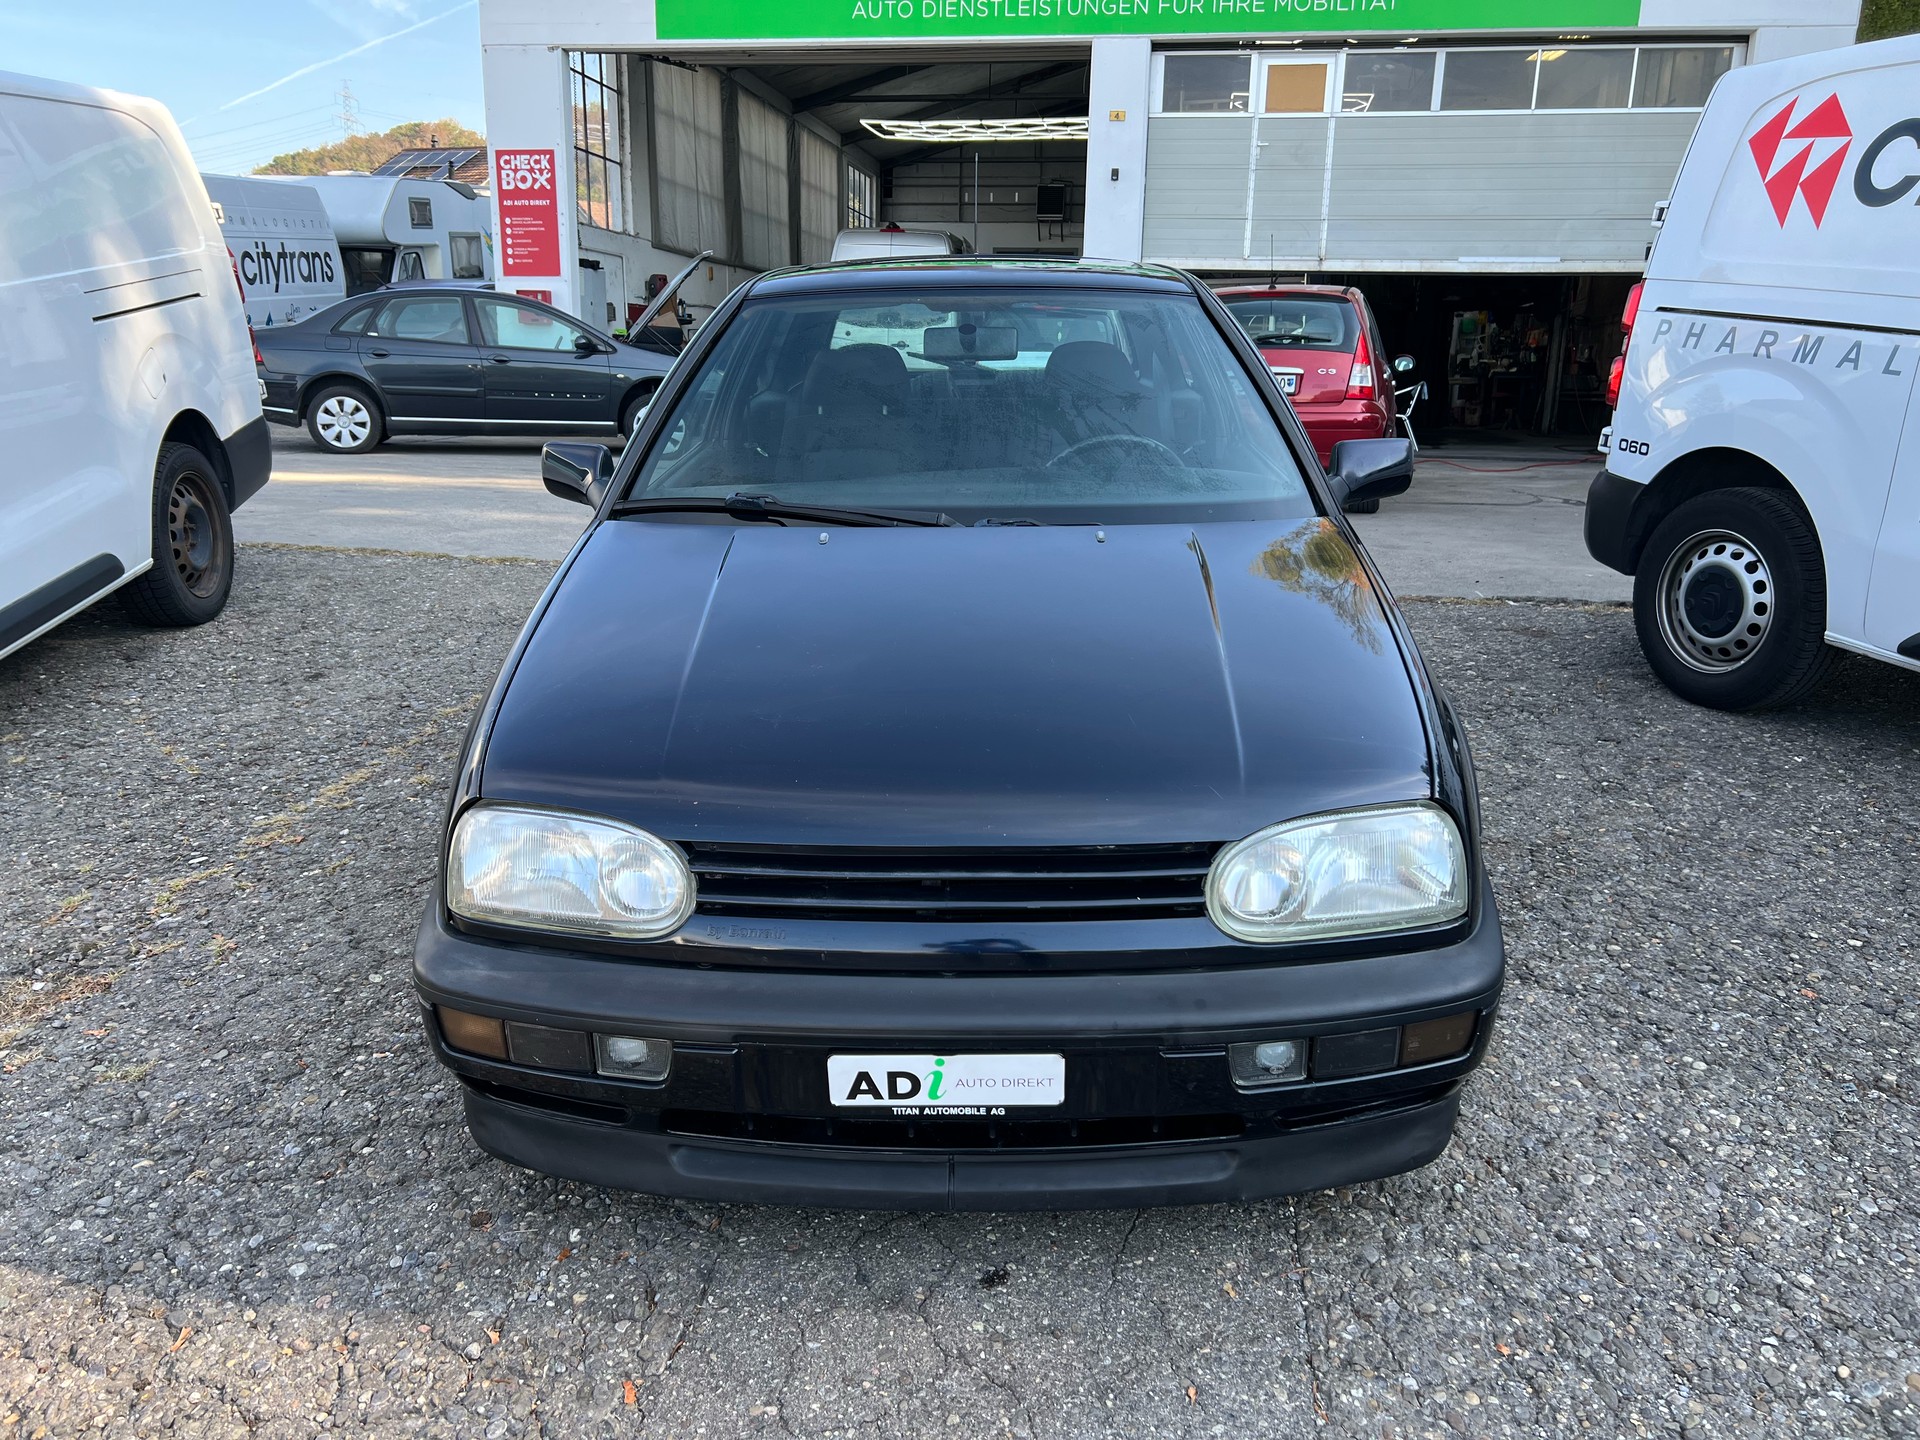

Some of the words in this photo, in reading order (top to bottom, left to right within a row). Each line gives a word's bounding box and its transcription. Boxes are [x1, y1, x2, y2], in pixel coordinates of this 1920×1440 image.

[851, 0, 913, 19] AUTO
[922, 0, 1148, 18] DIENSTLEISTUNGEN
[1213, 0, 1264, 13] IHRE
[500, 154, 551, 169] CHECK
[501, 169, 551, 190] BOX
[240, 240, 335, 293] citytrans
[1651, 318, 1903, 377] PHARMAL
[1618, 438, 1650, 456] 060
[955, 1078, 997, 1088] AUTO
[1001, 1078, 1054, 1088] DIREKT
[892, 1107, 920, 1116] TITAN
[923, 1106, 987, 1116] AUTOMOBILE
[990, 1107, 1006, 1116] AG
